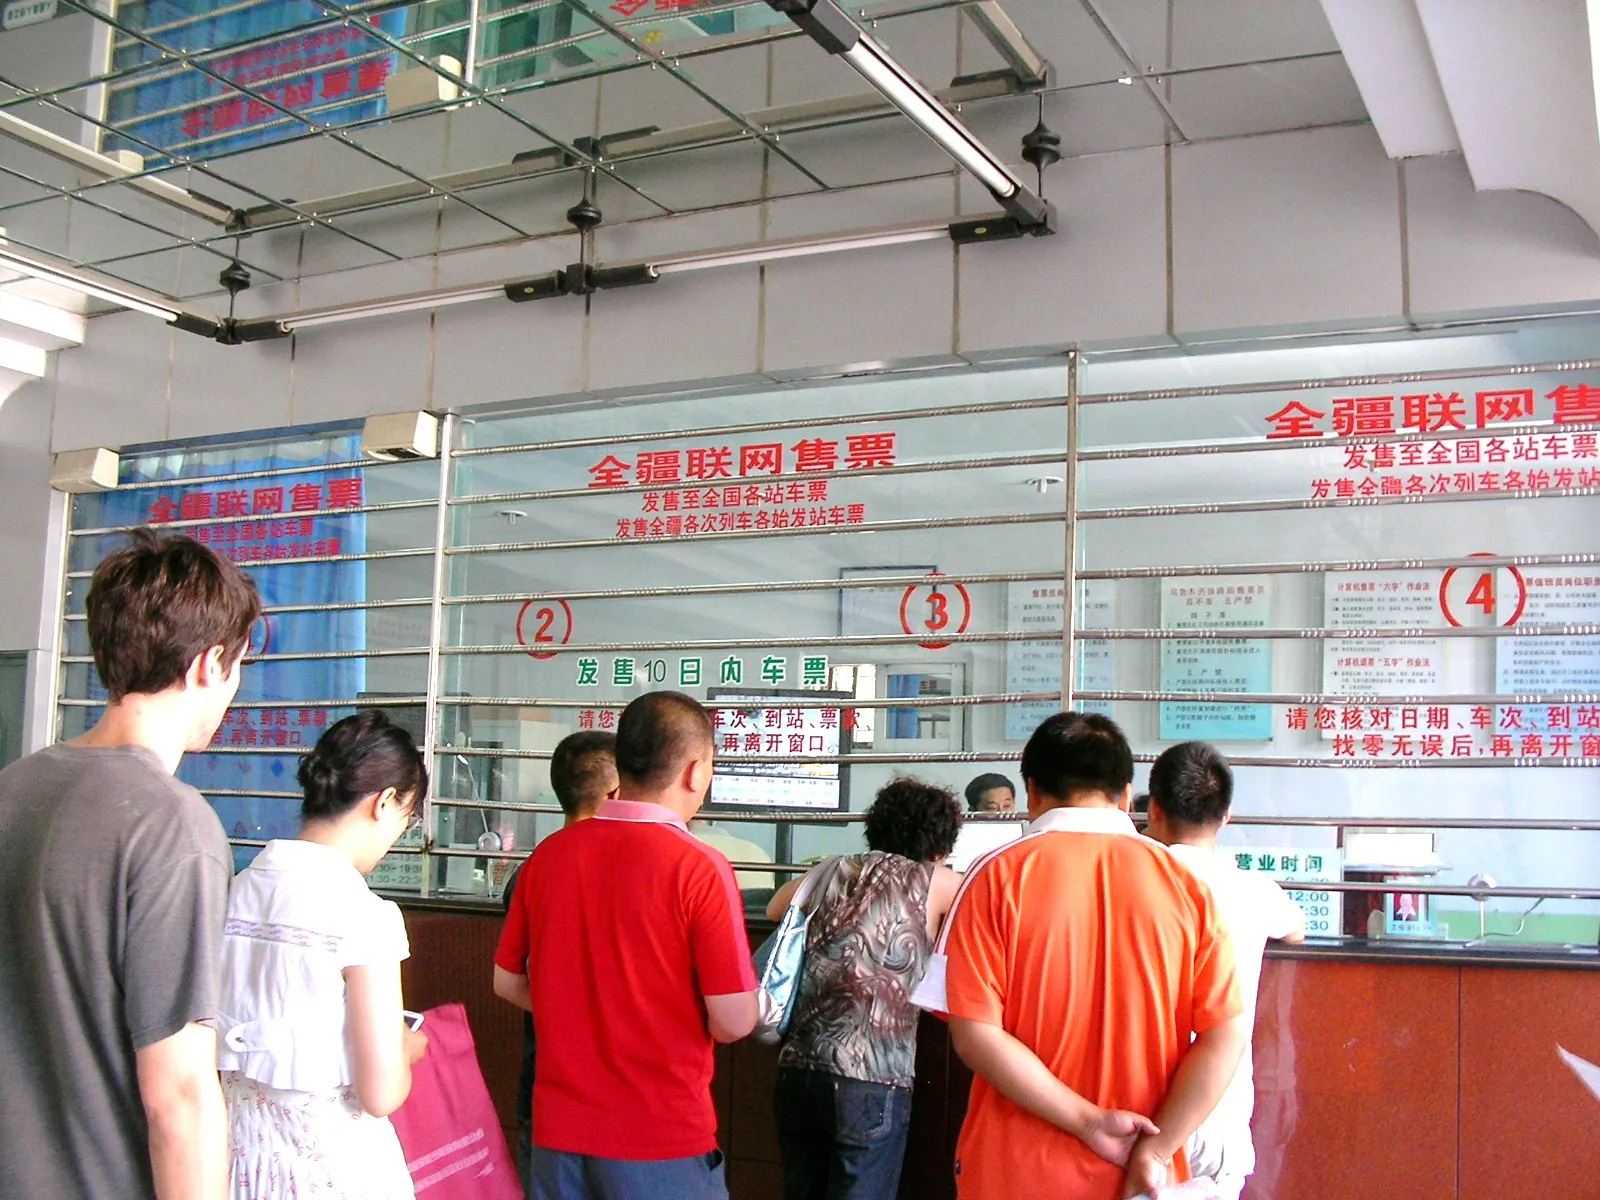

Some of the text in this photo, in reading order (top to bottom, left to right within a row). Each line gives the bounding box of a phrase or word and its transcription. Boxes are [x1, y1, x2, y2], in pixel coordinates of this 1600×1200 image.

[588, 433, 896, 488] 全疆联网售票
[1344, 433, 1598, 469] 发售至全国各站车票
[148, 478, 363, 524] 全疆联网售票
[642, 480, 828, 512] 发售至全国各站车票
[616, 504, 865, 538] 发售全疆各次列车各始发站车票
[1466, 572, 1496, 614] 4
[535, 608, 554, 642] 2
[924, 592, 949, 631] 3
[579, 709, 624, 728] 请您
[1234, 853, 1323, 872] 营业时间
